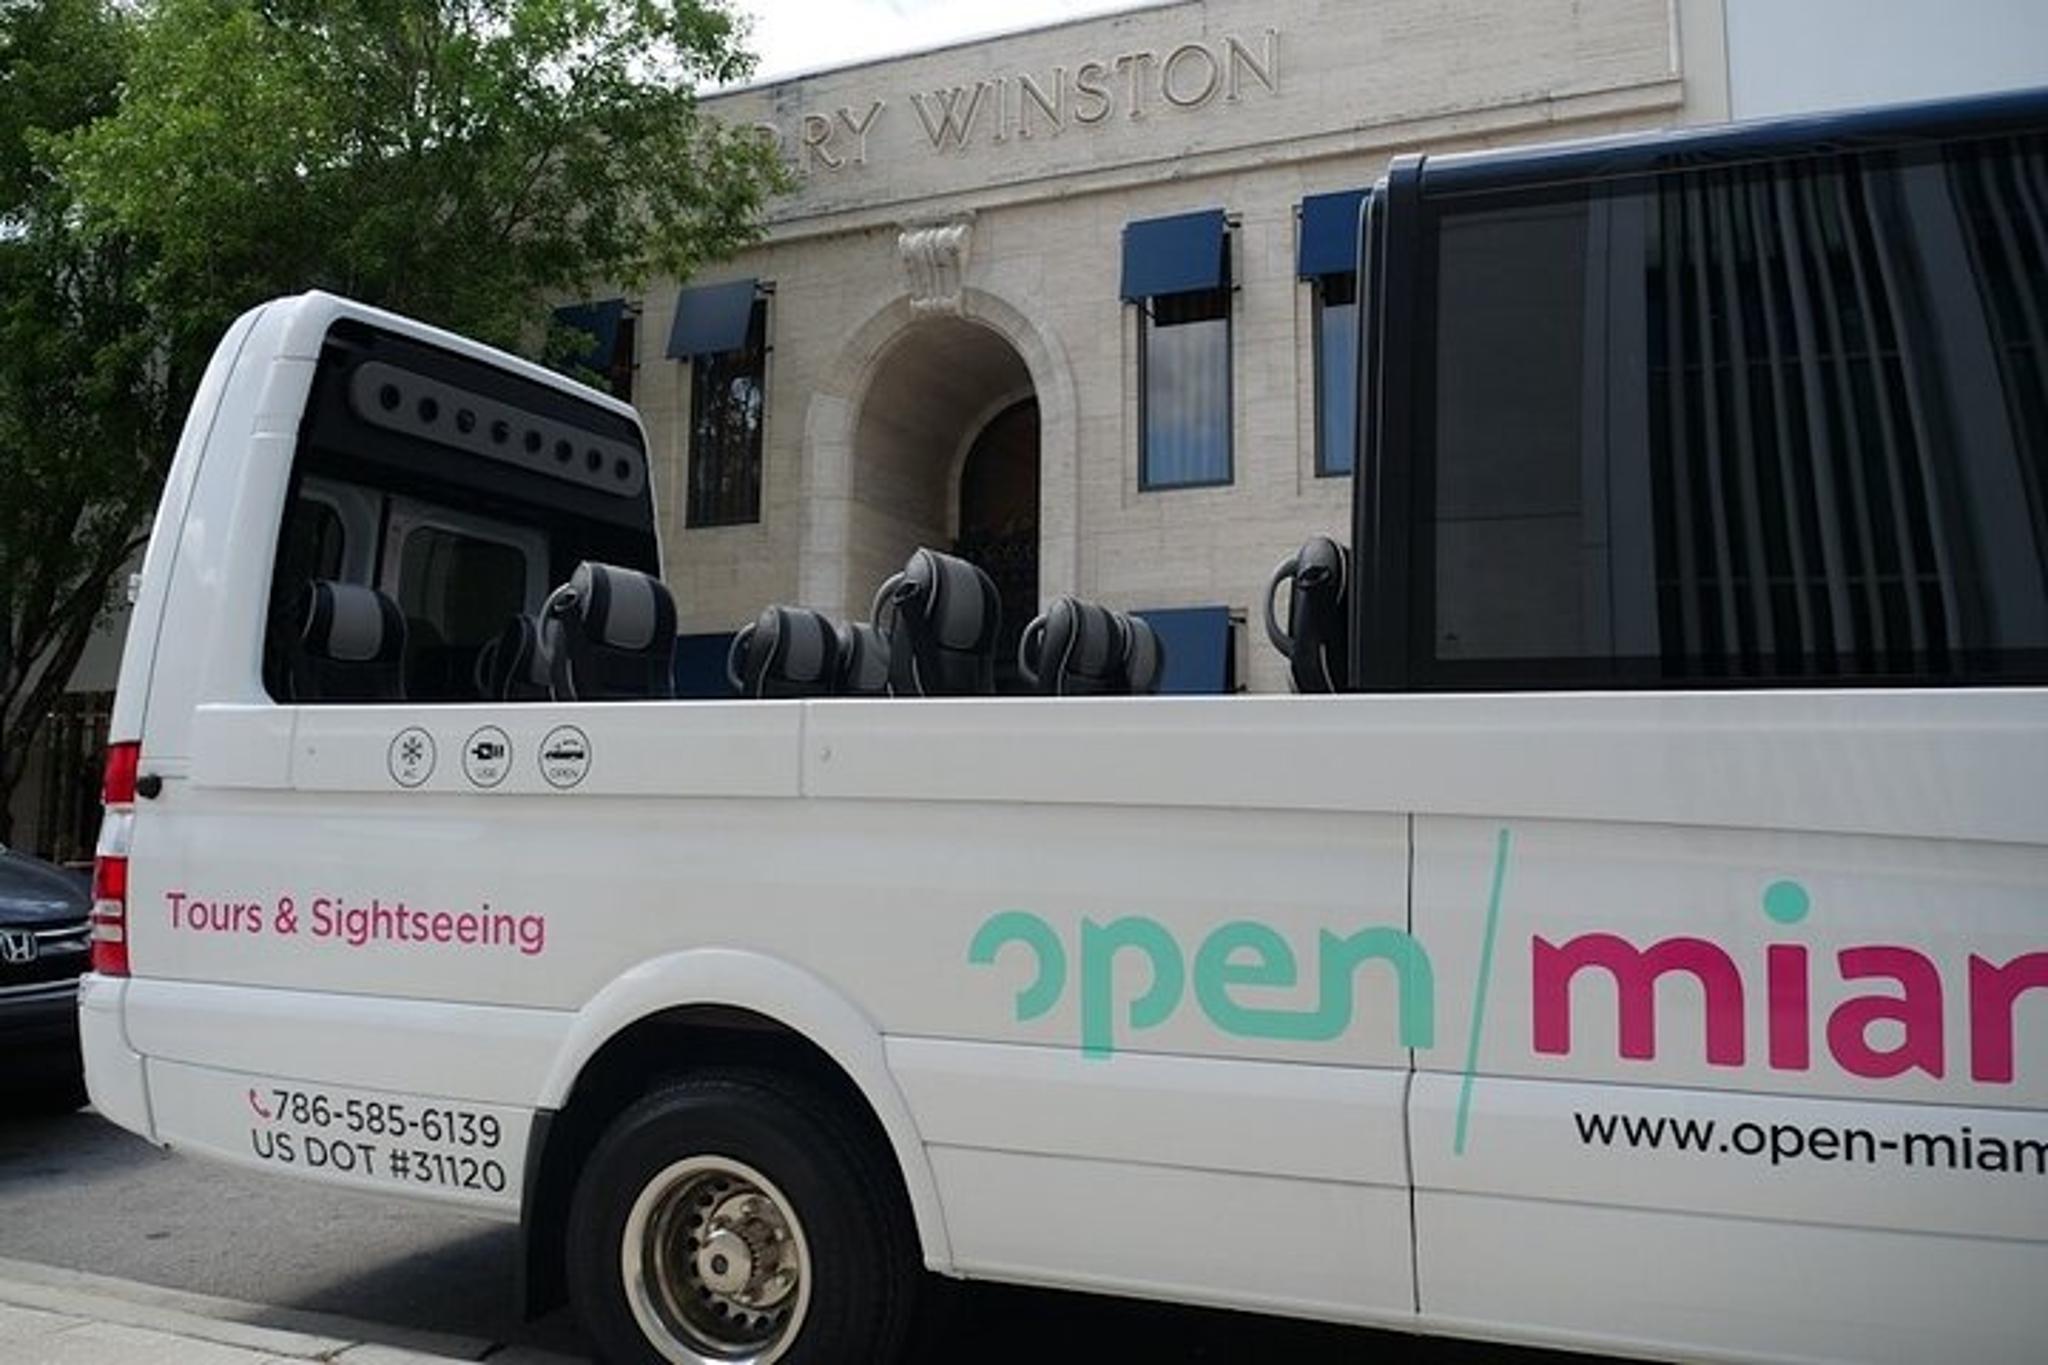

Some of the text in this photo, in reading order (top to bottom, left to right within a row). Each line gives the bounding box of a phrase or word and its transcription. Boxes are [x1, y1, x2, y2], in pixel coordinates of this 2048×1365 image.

[910, 28, 1281, 154] WINSTON
[166, 892, 545, 955] Tours & Sightseeing
[968, 910, 1435, 1060] open
[273, 1089, 501, 1148] 786-585-6139
[252, 1129, 506, 1193] US DOT #31120
